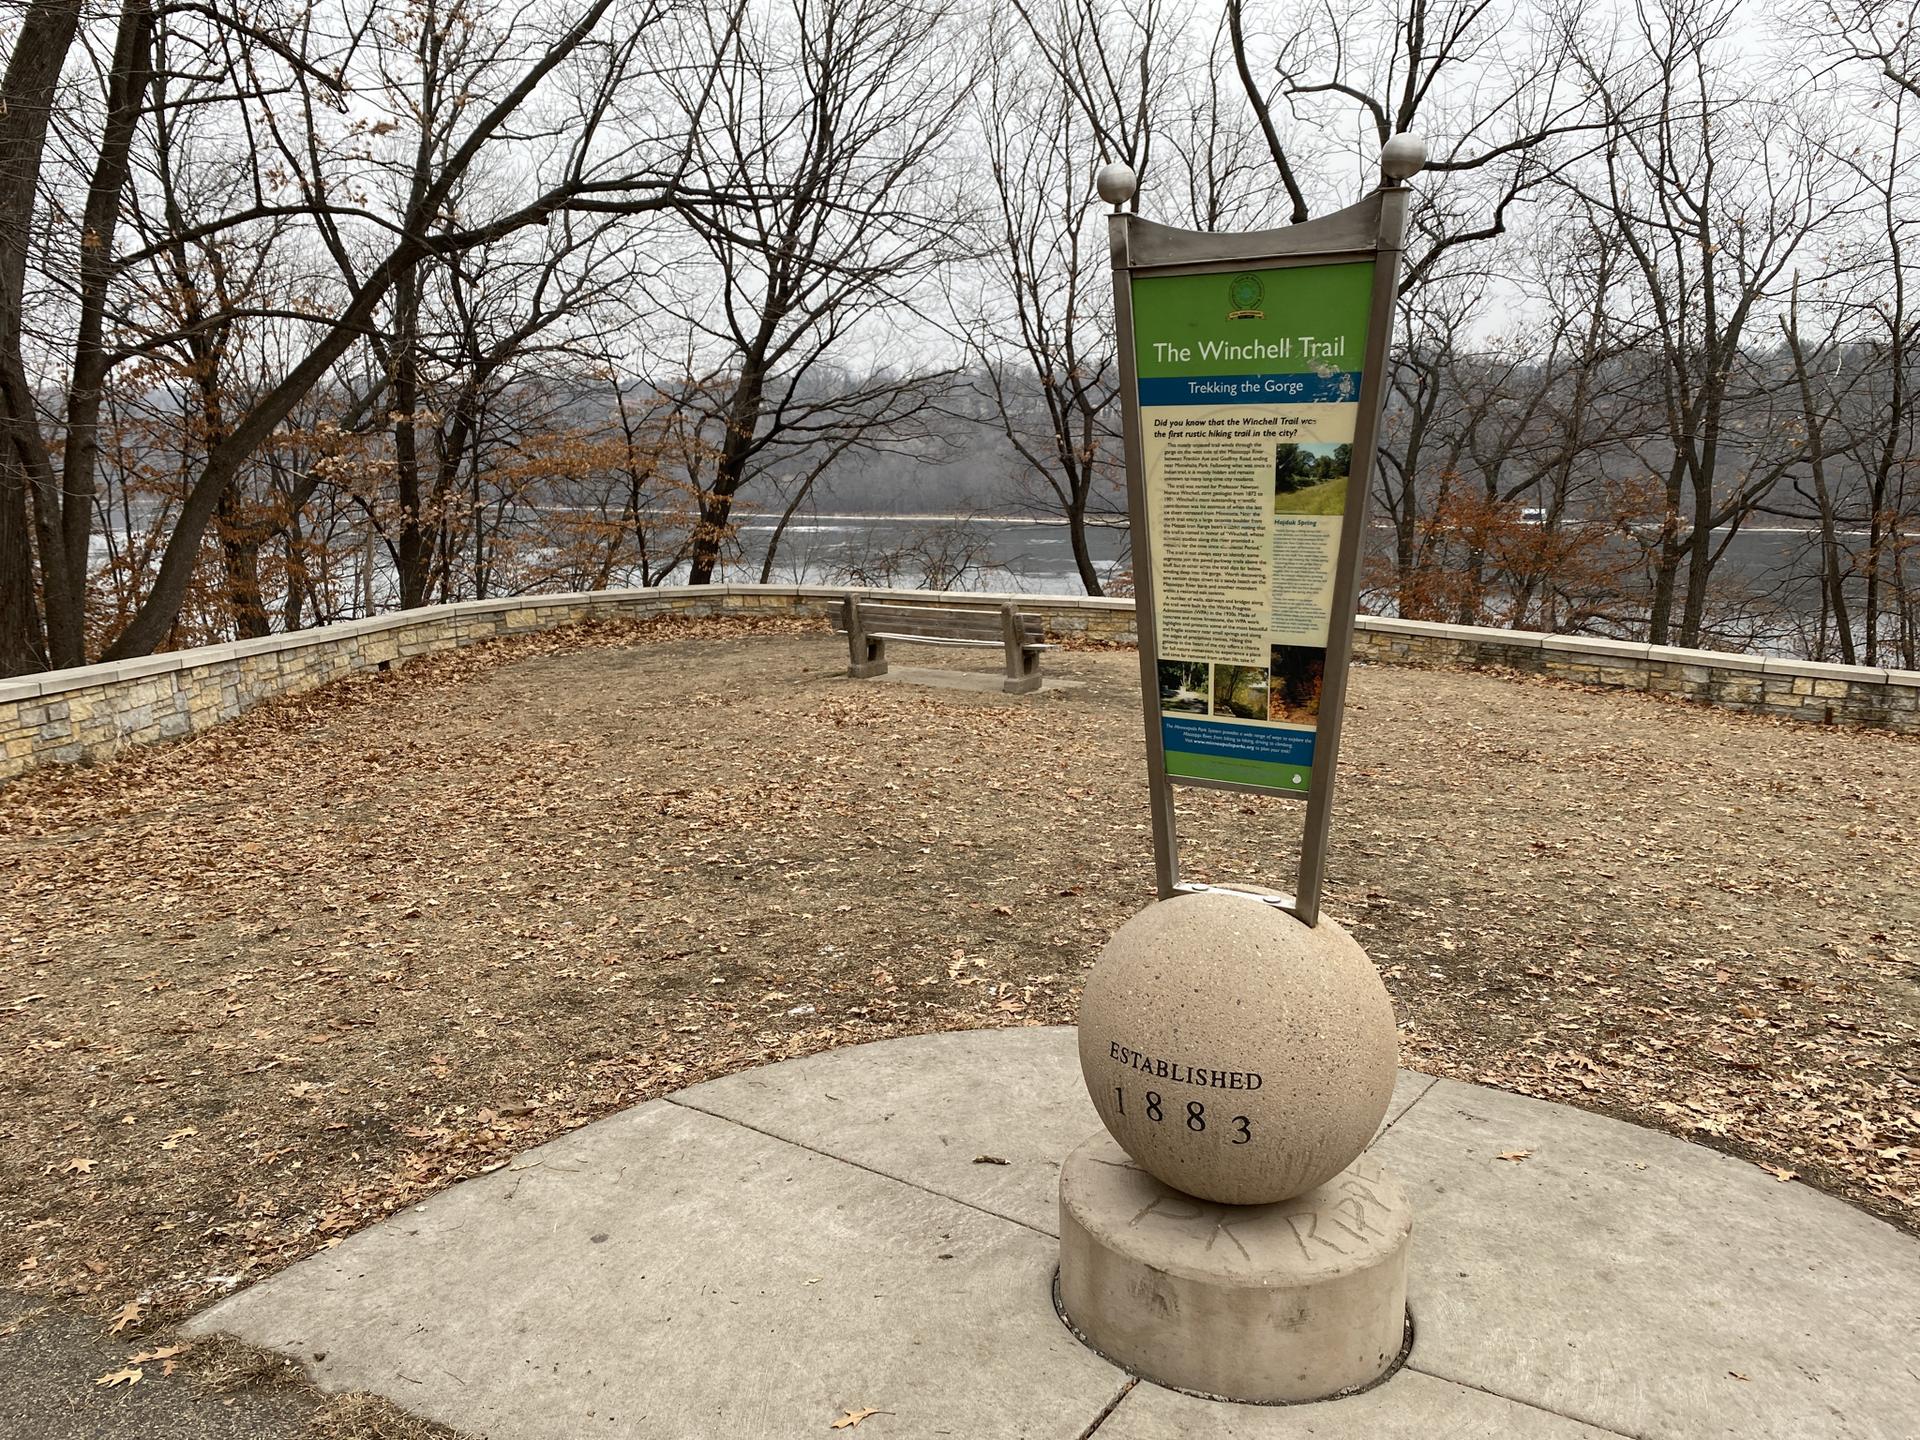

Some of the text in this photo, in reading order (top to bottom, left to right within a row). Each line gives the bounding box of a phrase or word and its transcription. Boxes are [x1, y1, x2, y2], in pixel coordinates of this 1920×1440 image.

[1153, 336, 1344, 362] The Winchell Trail
[1188, 380, 1303, 396] Trekking the Gorge
[1168, 430, 1183, 439] first
[1208, 429, 1231, 439] hiking
[1279, 428, 1297, 438] city?
[1110, 1041, 1262, 1090] ESTABLISHED
[1114, 1086, 1252, 1145] 1883
